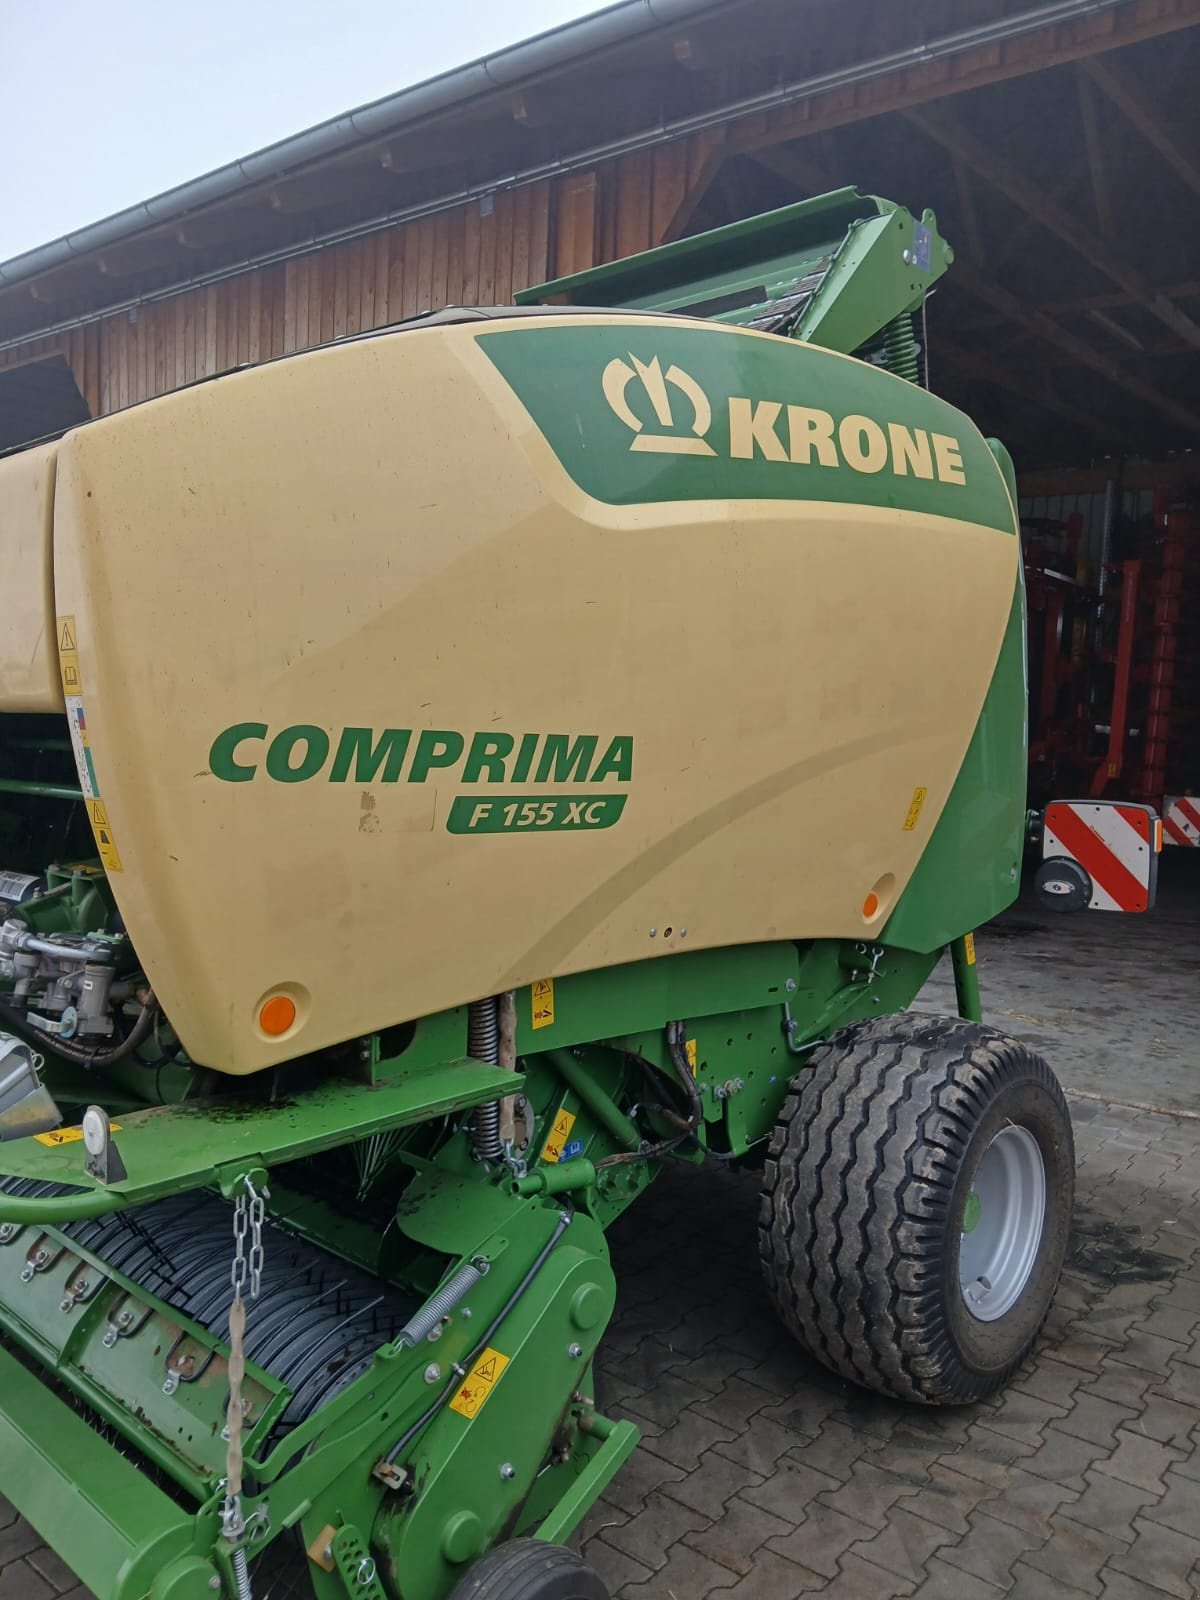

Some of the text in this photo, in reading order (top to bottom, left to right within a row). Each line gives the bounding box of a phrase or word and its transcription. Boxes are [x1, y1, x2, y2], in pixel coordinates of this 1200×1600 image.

[728, 397, 967, 486] KRONE
[209, 722, 634, 783] COMPRIMA
[468, 801, 606, 827] F 155 XC
